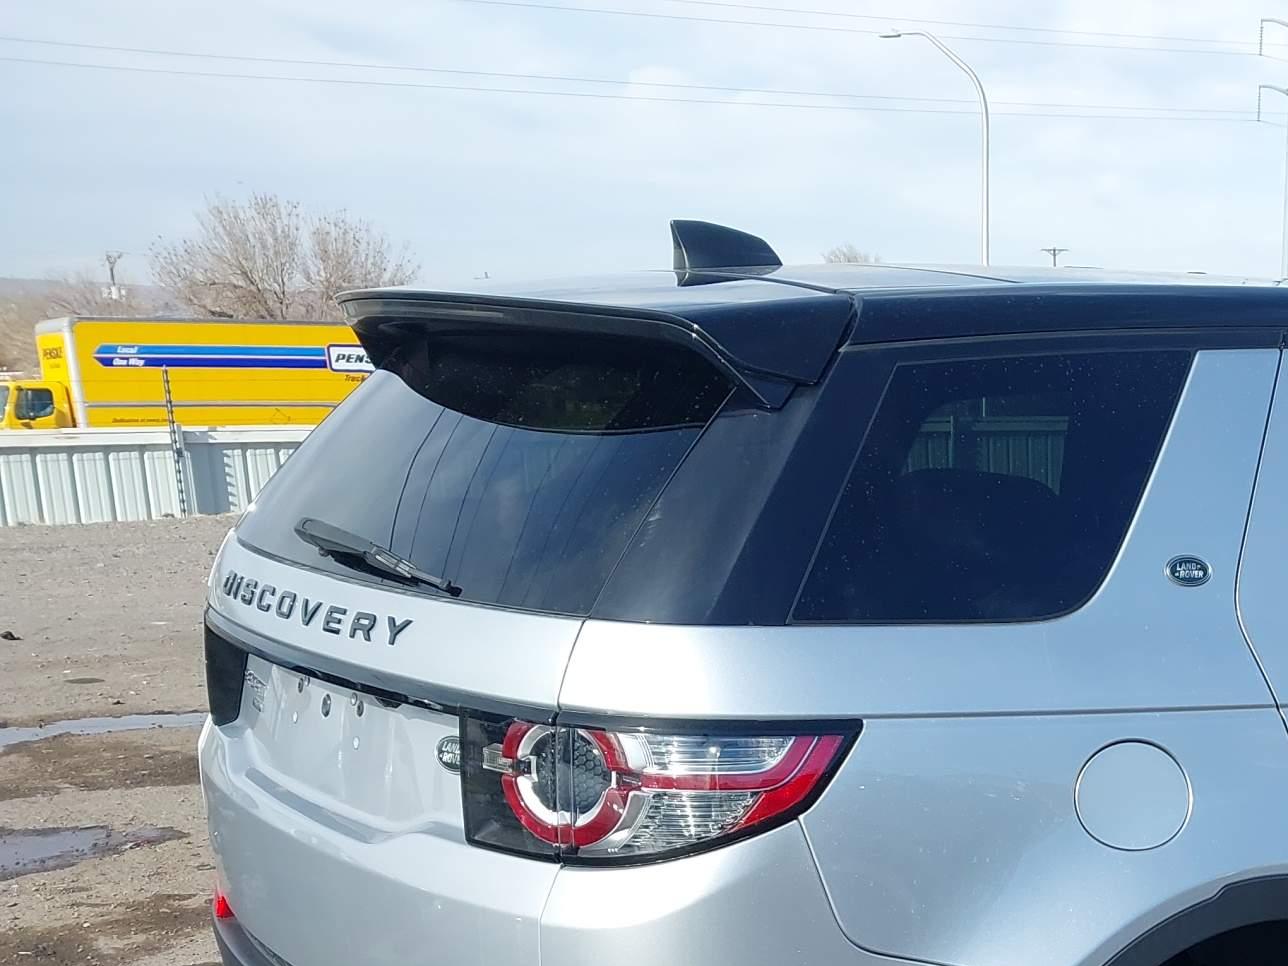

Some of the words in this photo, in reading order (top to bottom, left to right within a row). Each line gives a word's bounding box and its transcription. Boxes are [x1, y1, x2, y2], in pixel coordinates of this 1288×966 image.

[1176, 562, 1196, 571] LAND
[1180, 570, 1204, 579] ROVER
[223, 569, 414, 646] DISCOVERY
